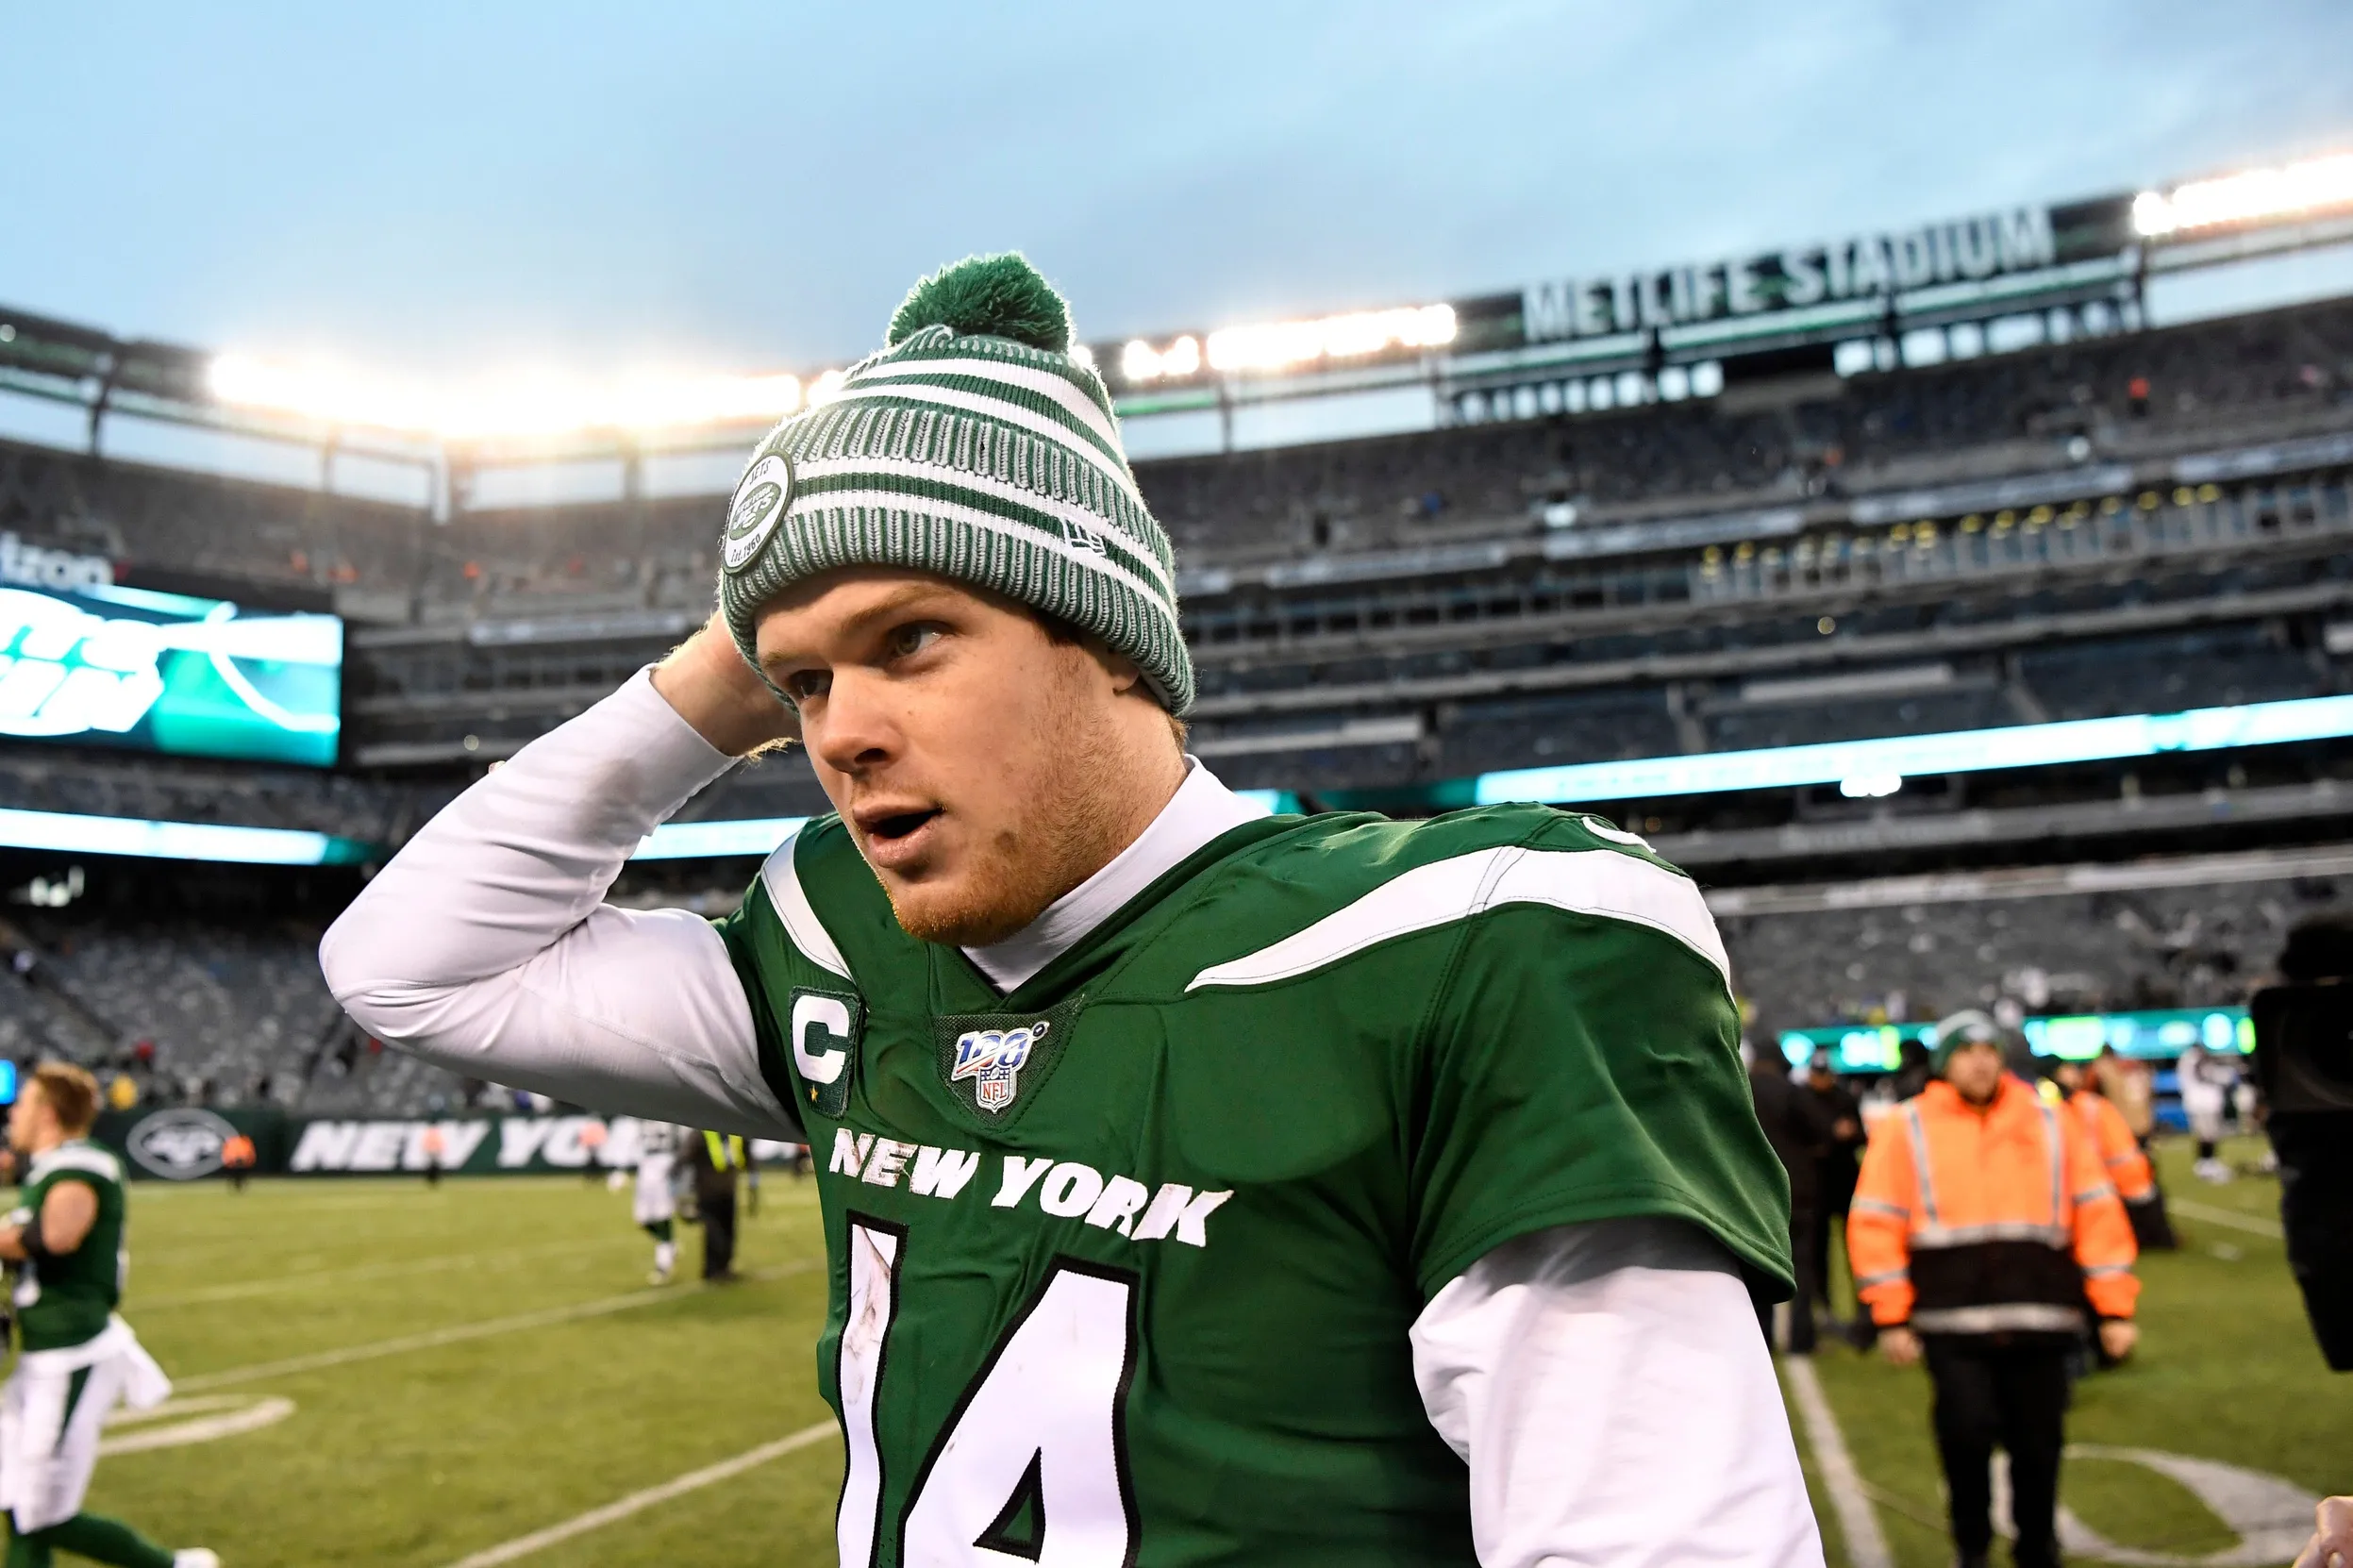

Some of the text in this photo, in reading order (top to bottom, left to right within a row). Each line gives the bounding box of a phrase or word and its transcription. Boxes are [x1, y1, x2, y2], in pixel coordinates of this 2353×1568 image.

[1525, 206, 2053, 342] METLIFE STADIUM
[792, 994, 848, 1083] C
[982, 1081, 1007, 1102] NFL
[292, 1121, 488, 1170] NEW
[828, 1127, 1234, 1247] NEW YORK
[836, 1209, 1141, 1568] 14
